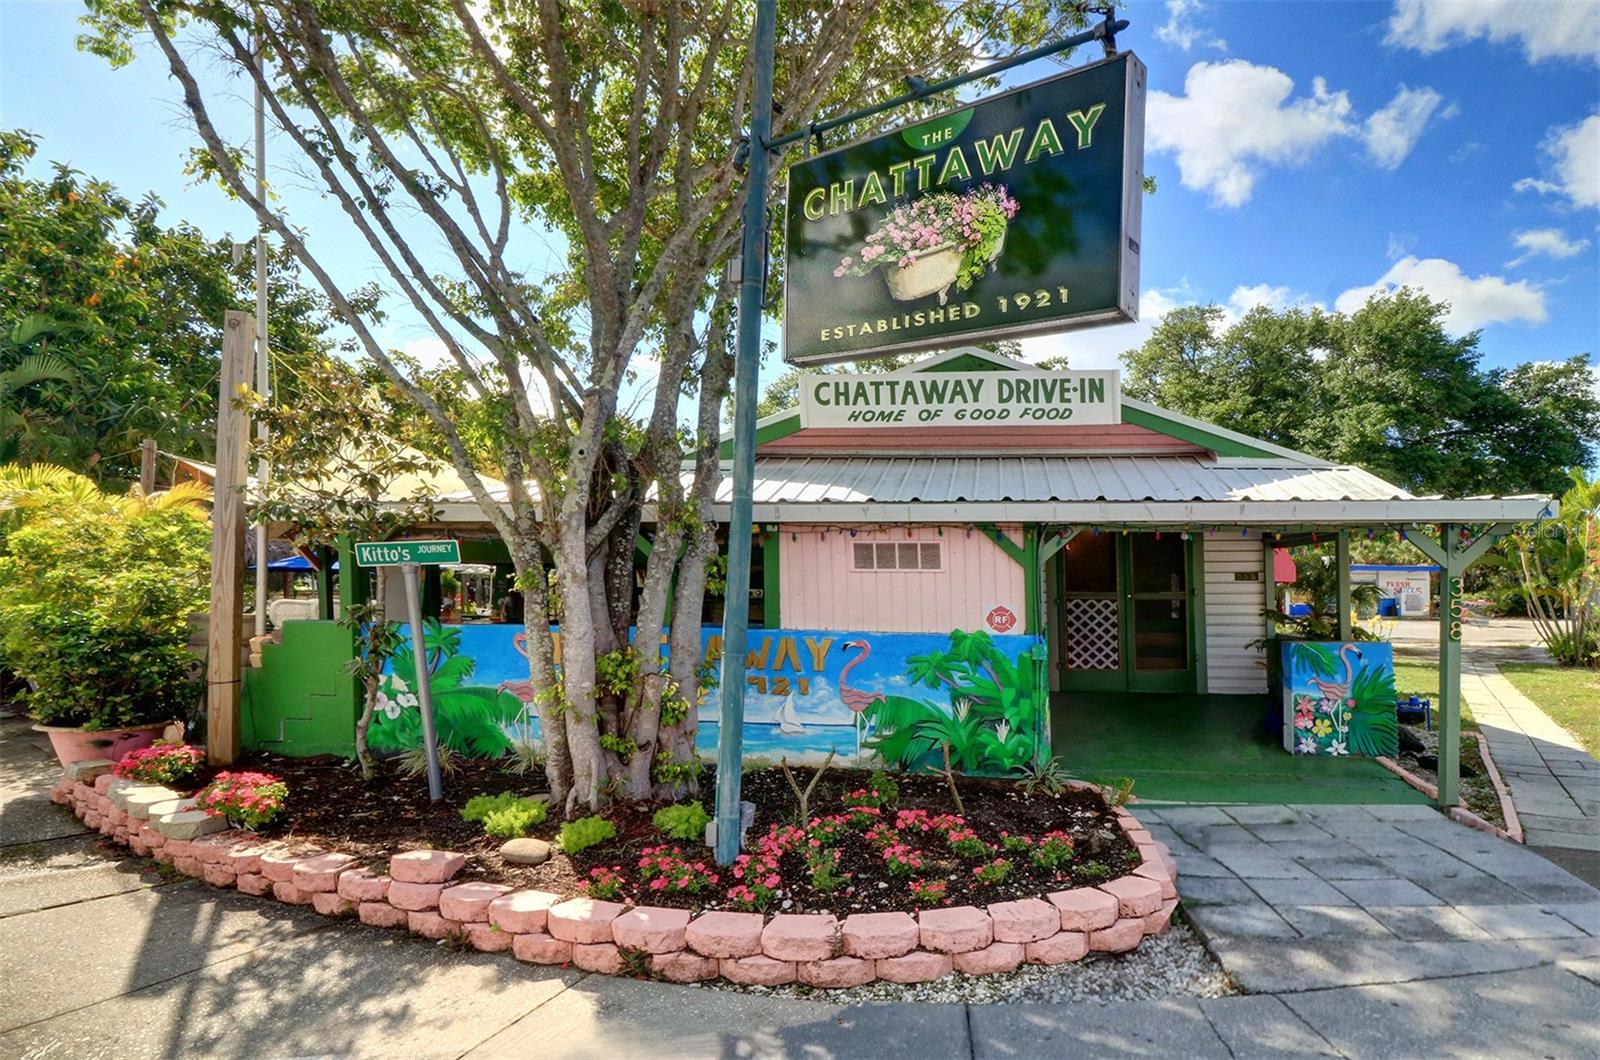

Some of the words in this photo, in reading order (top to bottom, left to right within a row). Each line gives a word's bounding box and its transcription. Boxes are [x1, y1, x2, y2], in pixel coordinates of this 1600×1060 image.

[921, 127, 953, 147] THE
[803, 102, 1107, 222] CHATTAWAY
[820, 302, 981, 342] ESTABLISHED
[996, 285, 1069, 314] 1921
[814, 378, 985, 407] CHATTAWAY
[847, 409, 906, 423] HOME
[918, 408, 944, 422] OF
[954, 408, 1011, 421] GOOD
[1019, 407, 1074, 421] FOOD
[361, 546, 411, 562] Kitto's
[417, 544, 452, 554] JOURNEY
[994, 615, 1009, 624] RF
[1451, 577, 1464, 640] 358
